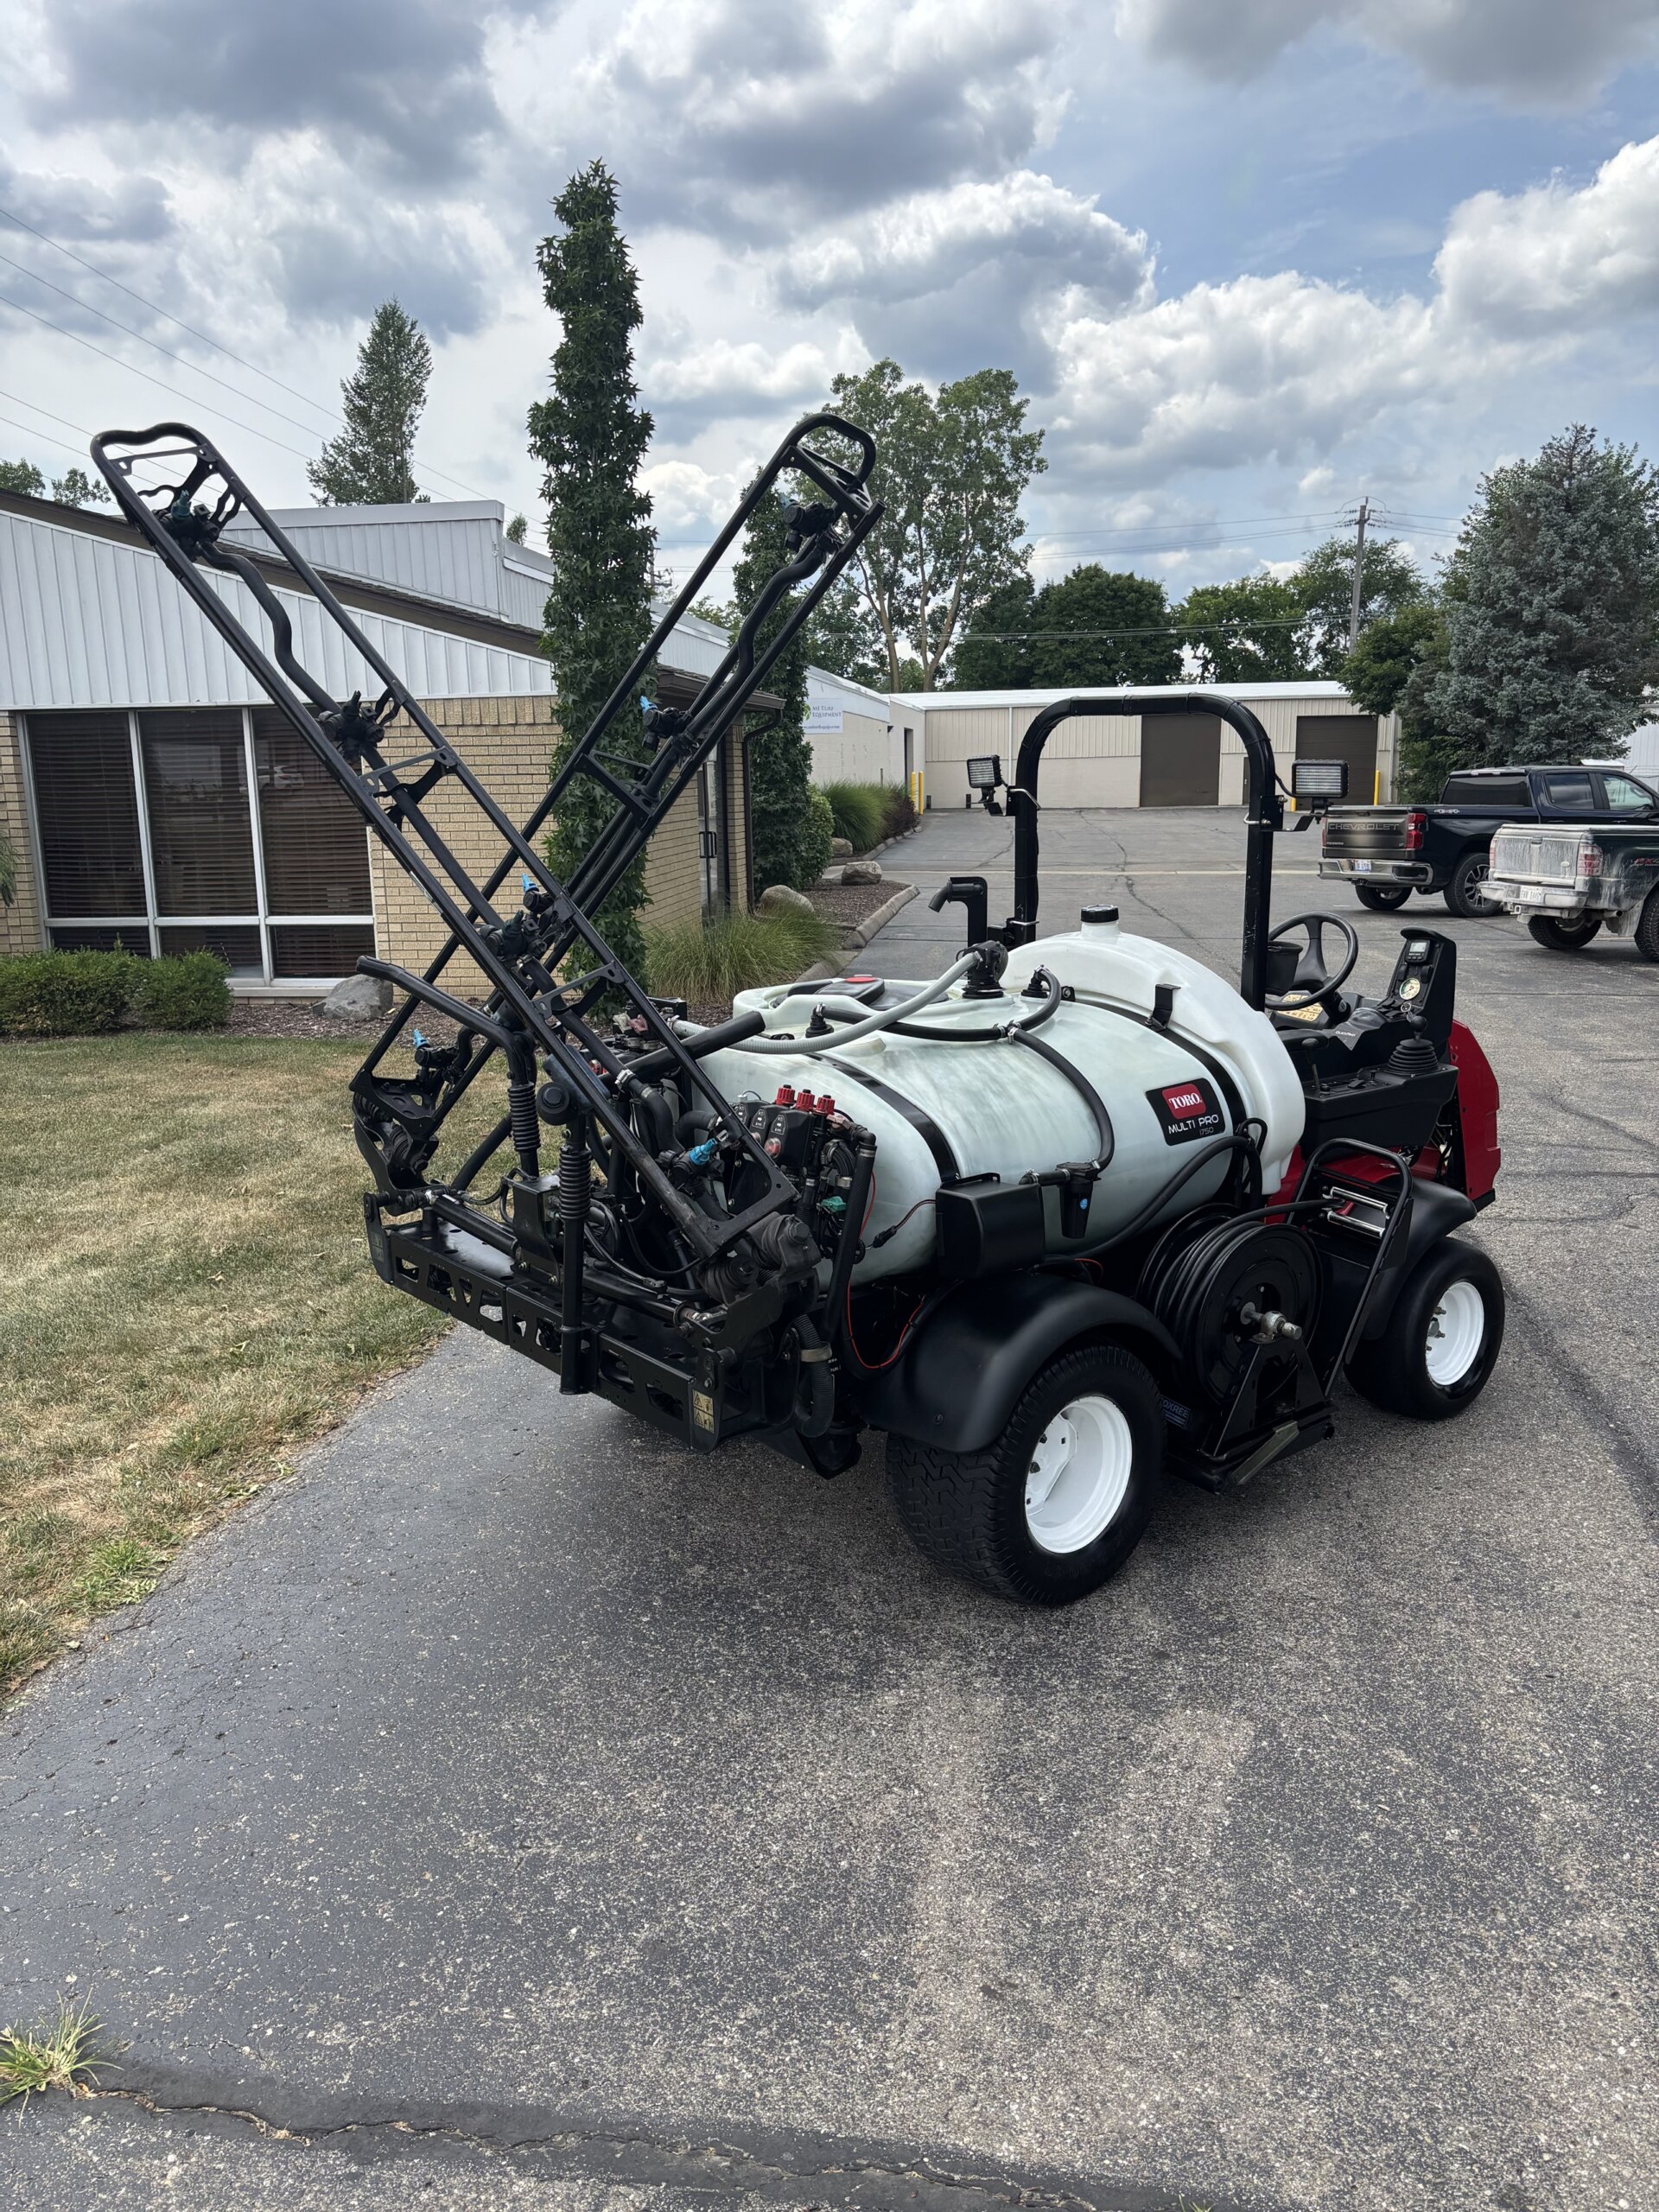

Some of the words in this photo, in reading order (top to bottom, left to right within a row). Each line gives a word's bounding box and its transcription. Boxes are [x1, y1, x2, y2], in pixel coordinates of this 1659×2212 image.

[1168, 1092, 1200, 1109] TORO
[1168, 1119, 1196, 1135] MULTI
[1198, 1114, 1219, 1127] PRO
[1198, 1126, 1214, 1136] 1750
[1160, 1396, 1189, 1418] OXREE
